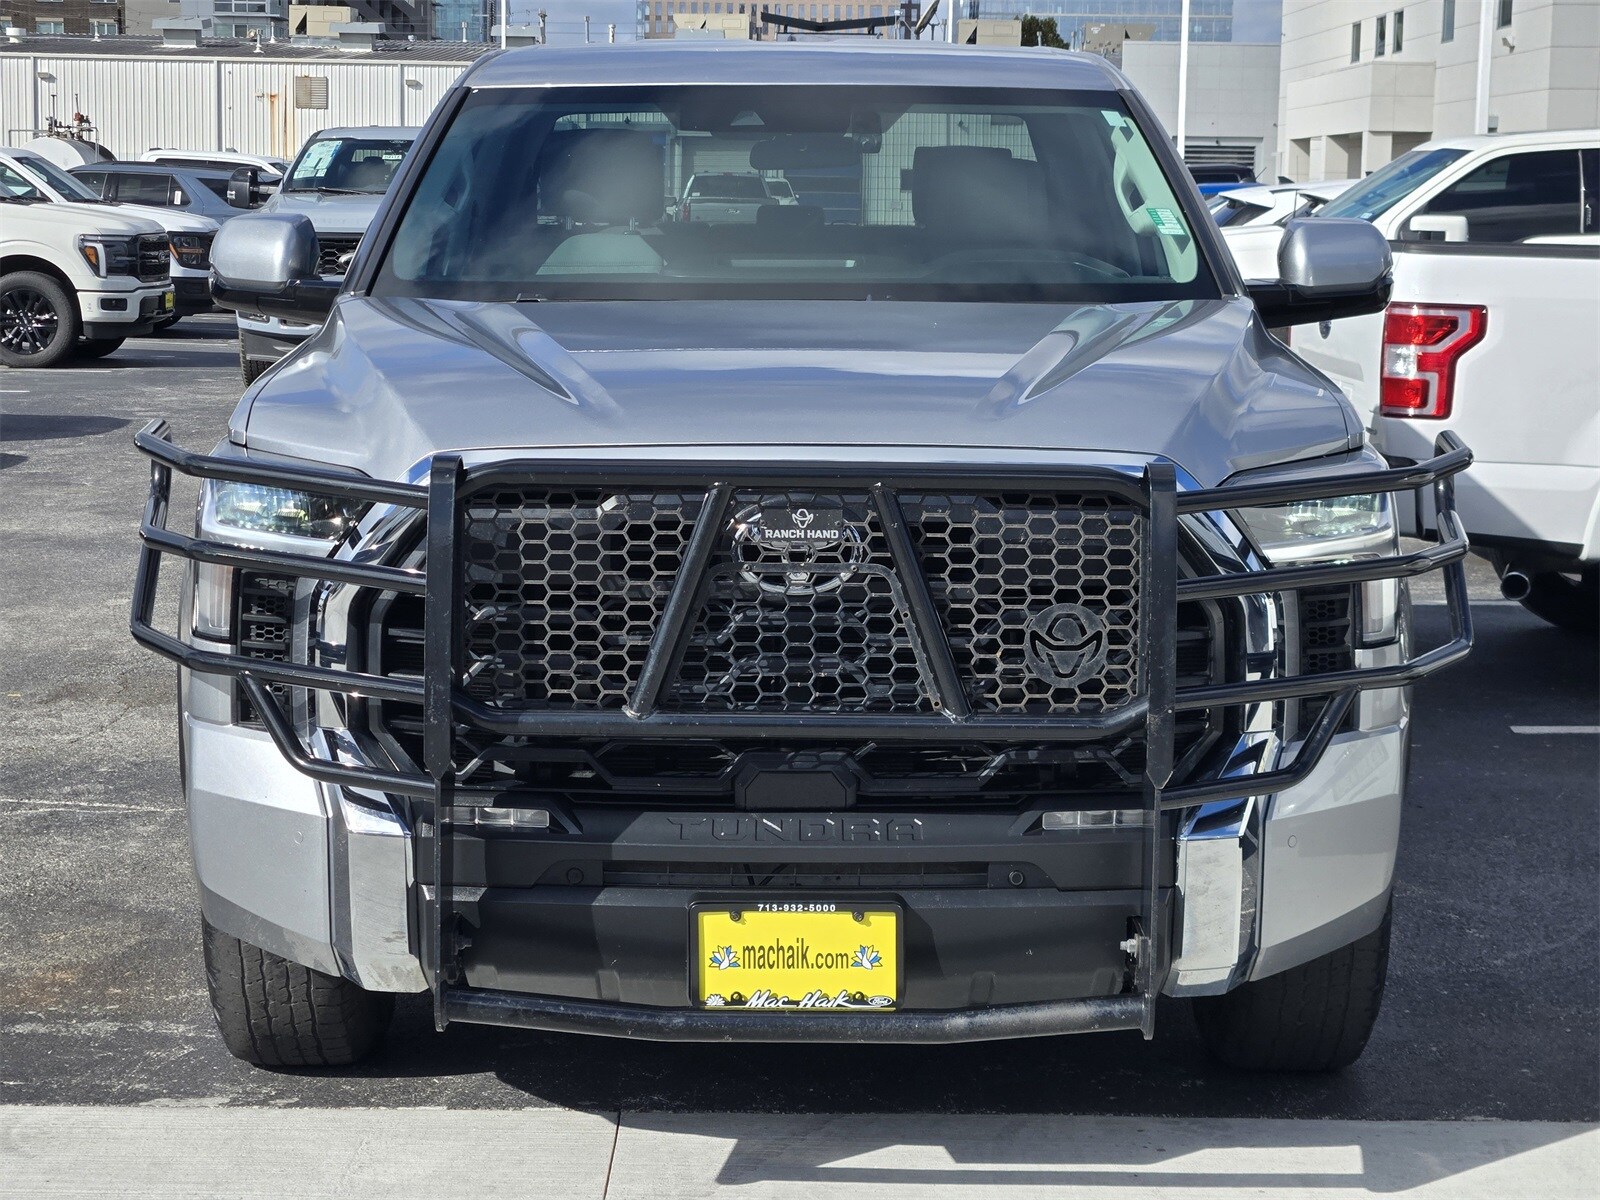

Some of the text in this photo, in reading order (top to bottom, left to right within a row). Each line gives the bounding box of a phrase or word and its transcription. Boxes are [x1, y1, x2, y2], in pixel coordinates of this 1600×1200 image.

[765, 529, 839, 539] RANCH HAND
[666, 818, 924, 841] TUNDRA
[757, 903, 836, 912] 713-932-5000
[742, 937, 849, 970] machaik.com
[745, 989, 866, 1008] Mac Haik
[870, 996, 891, 1006] Ford
